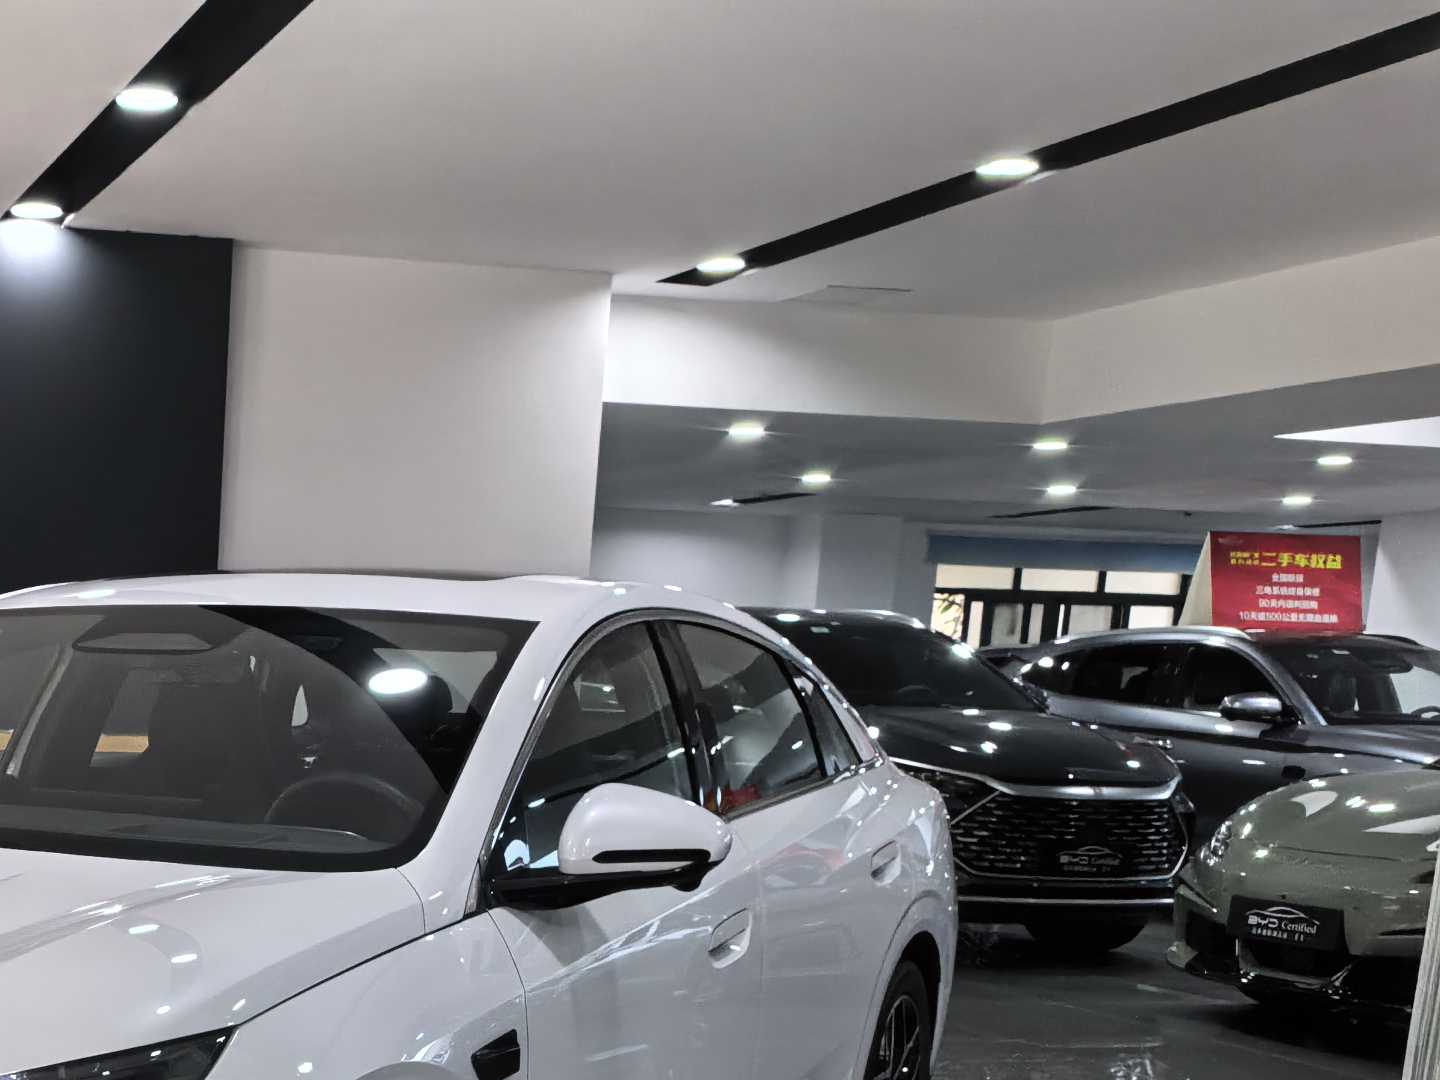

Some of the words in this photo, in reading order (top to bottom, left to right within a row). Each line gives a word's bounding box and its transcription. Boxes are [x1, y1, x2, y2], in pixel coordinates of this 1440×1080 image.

[1260, 552, 1342, 568] 二手车权益
